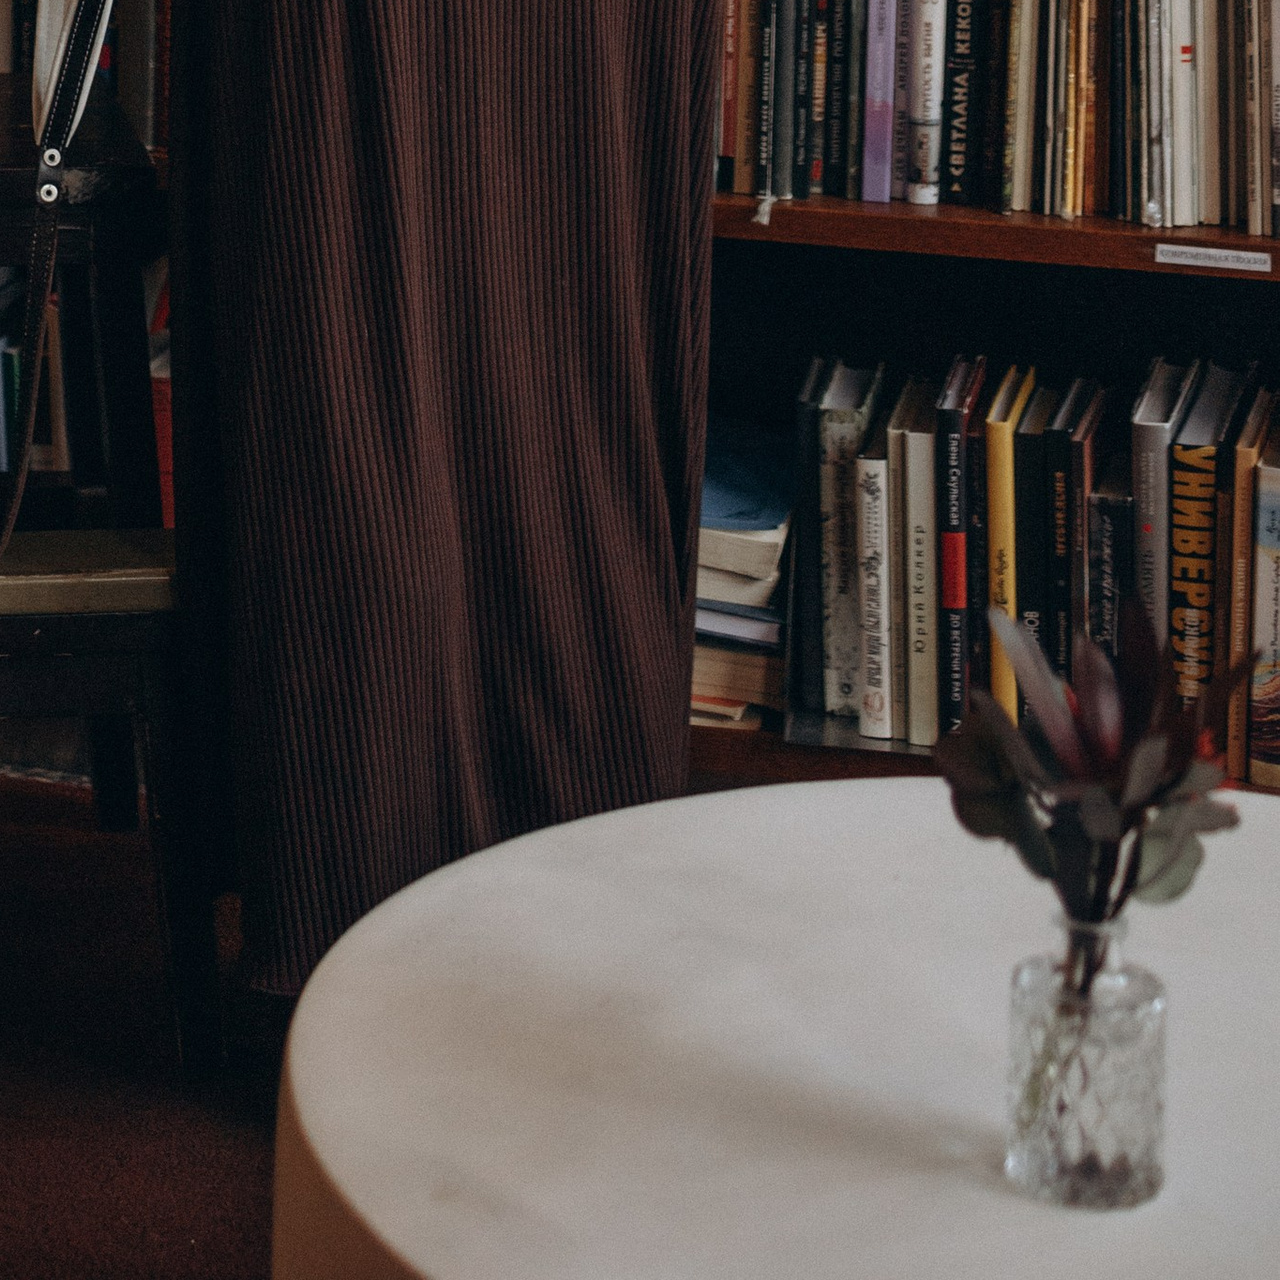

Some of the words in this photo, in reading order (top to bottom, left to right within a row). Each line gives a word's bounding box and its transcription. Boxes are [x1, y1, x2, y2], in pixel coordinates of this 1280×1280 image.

[897, 41, 909, 92] АНДРЕЙ
[950, 72, 971, 178] СВЕТЛАНА
[948, 432, 961, 466] Елена
[947, 468, 963, 525] Скульская
[913, 525, 928, 595] Колкер
[914, 602, 927, 654] Юрий
[950, 613, 963, 629] ДО
[949, 632, 963, 671] ВСТРЕЧИ
[949, 683, 963, 702] РАЮ
